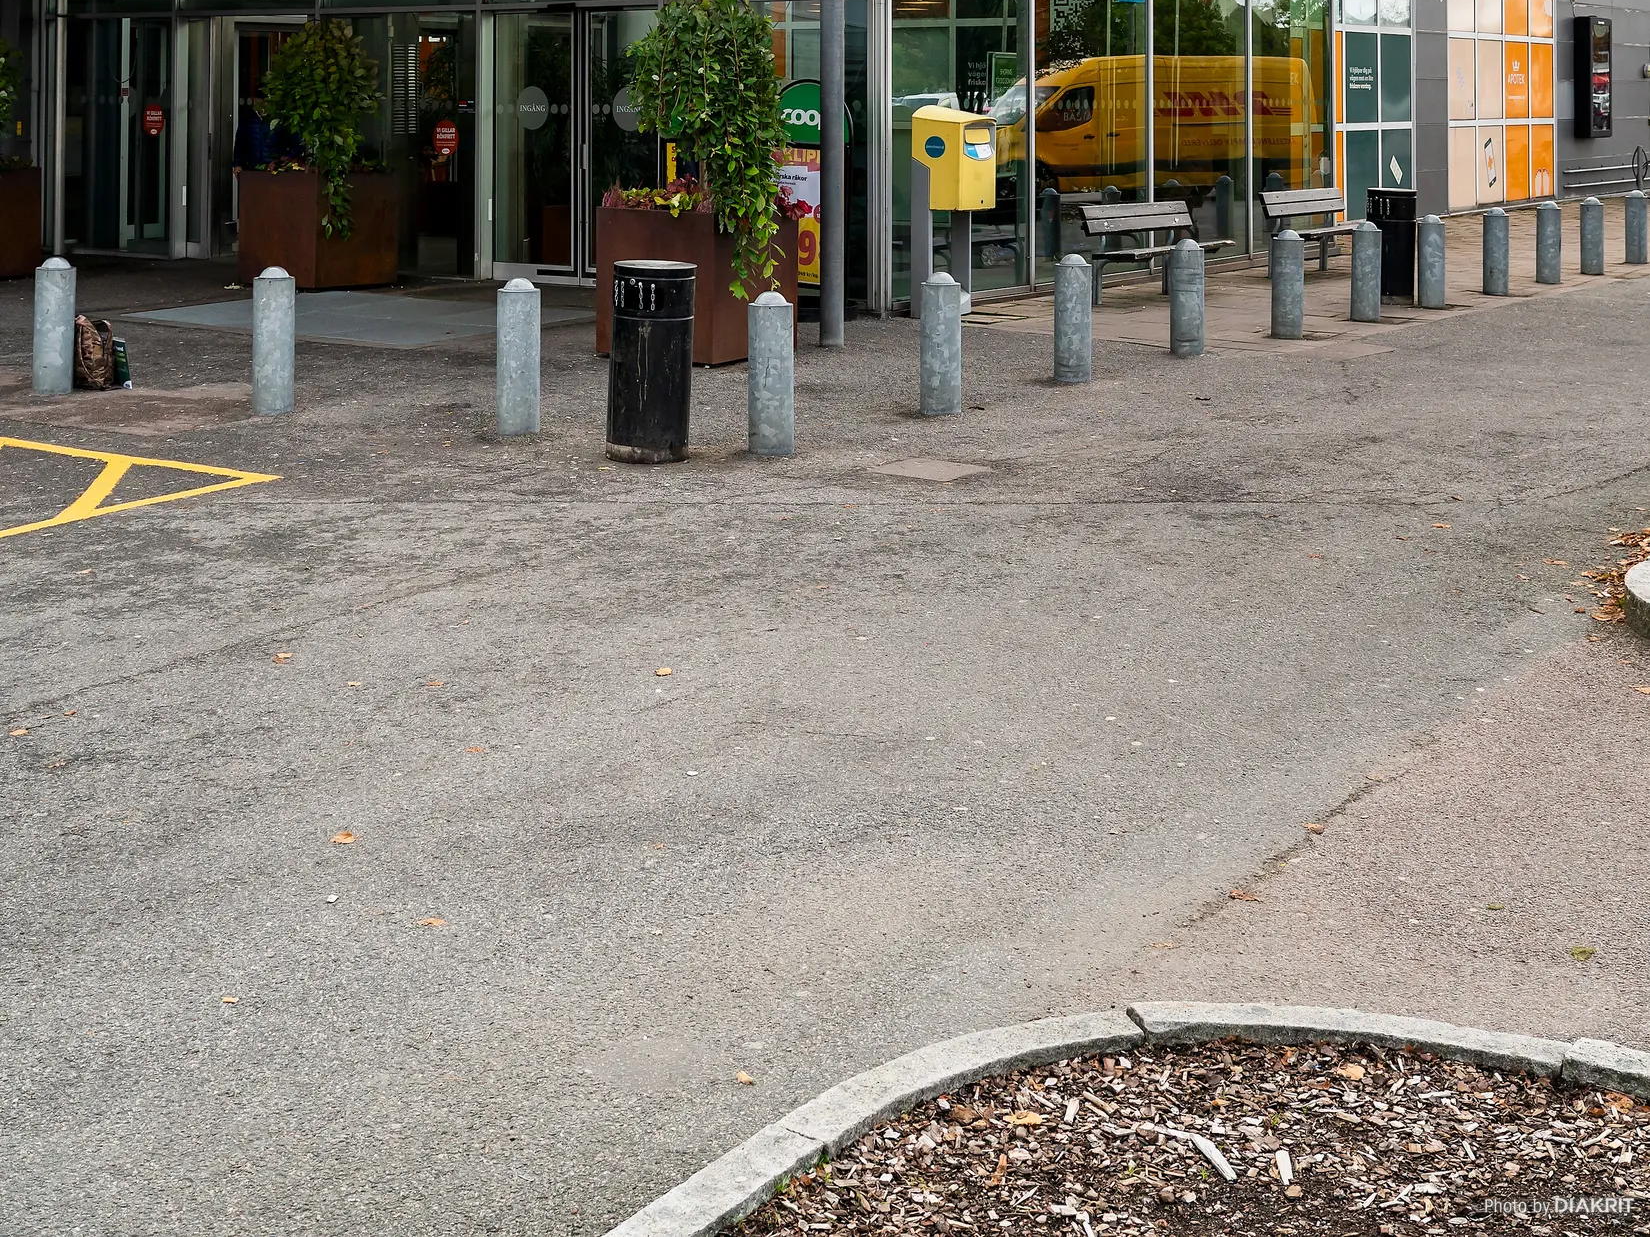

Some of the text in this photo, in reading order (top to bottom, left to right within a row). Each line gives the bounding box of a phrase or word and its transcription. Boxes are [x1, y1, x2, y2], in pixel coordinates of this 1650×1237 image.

[1508, 73, 1525, 84] APOTEK
[520, 103, 546, 112] INGÅNG
[781, 108, 820, 131] coo
[783, 148, 820, 164] KLIP
